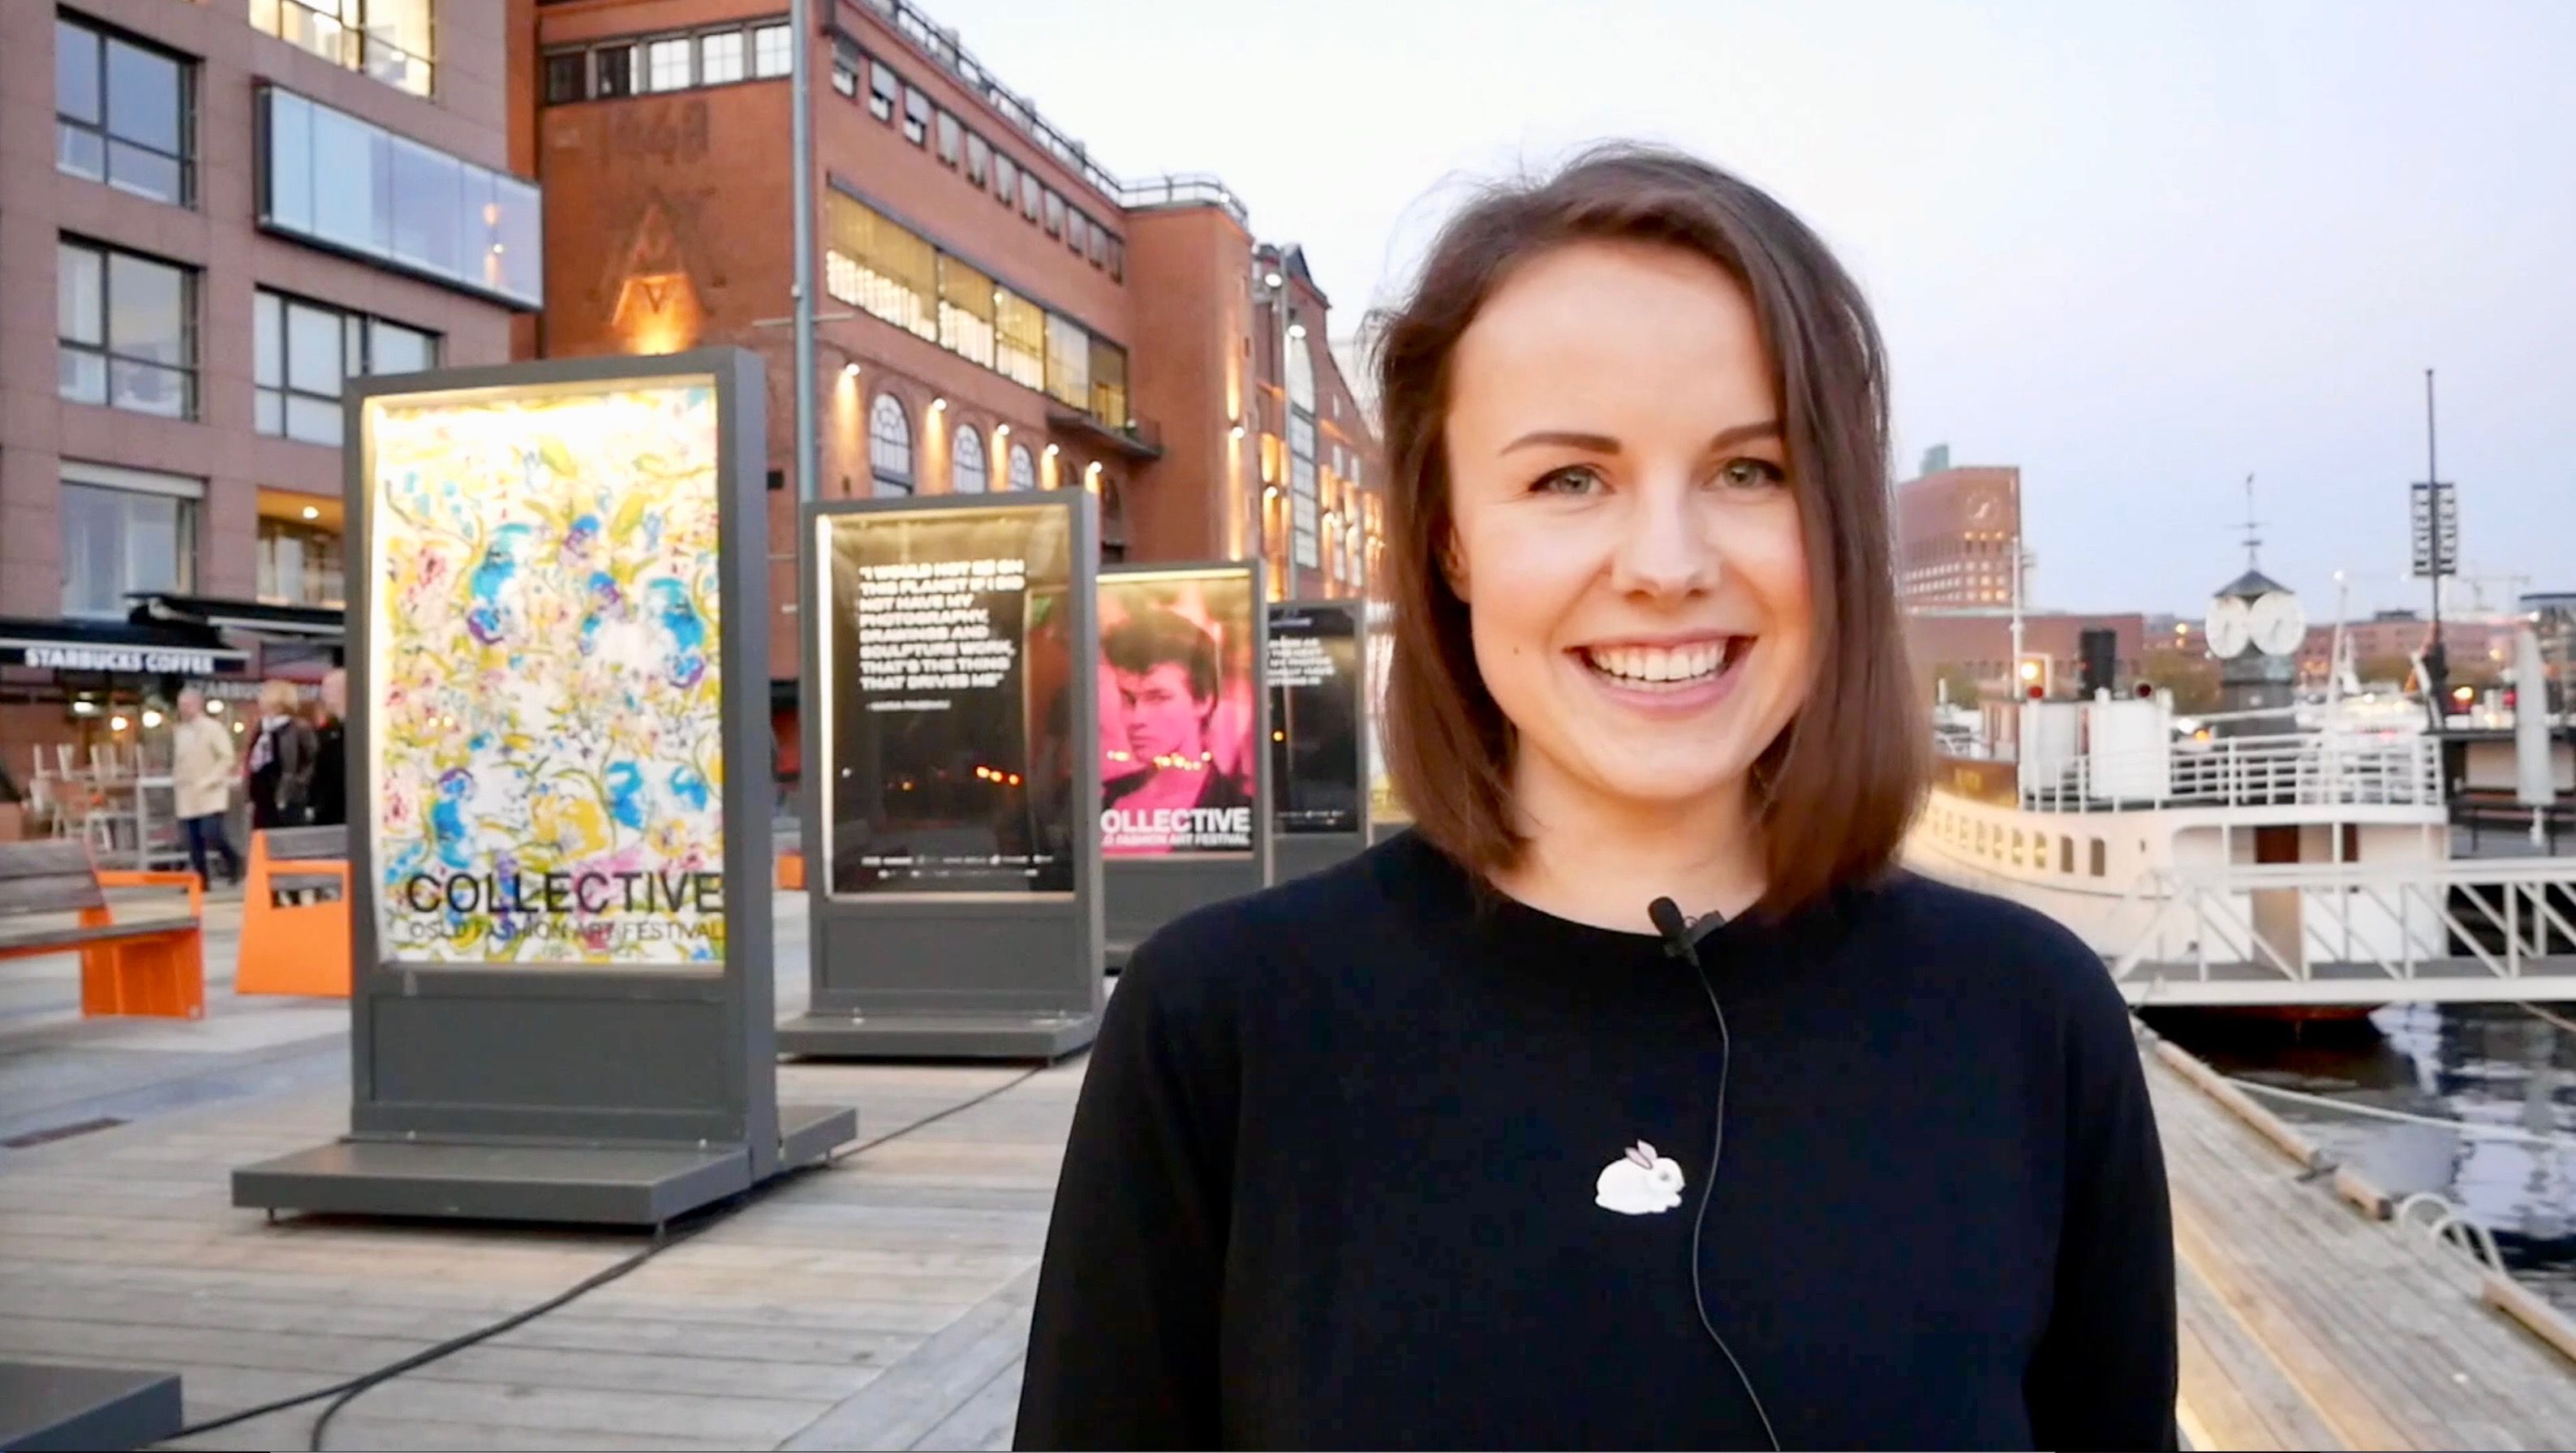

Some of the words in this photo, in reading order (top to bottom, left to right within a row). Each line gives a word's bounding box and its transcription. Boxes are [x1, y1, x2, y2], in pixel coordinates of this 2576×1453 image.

[24, 648, 142, 672] STARBUCKS
[144, 653, 215, 674] COFFEE
[1099, 806, 1251, 834] OLLECTIVE
[407, 871, 724, 914] COLLECTIVE
[622, 921, 725, 942] FESTIVAL
